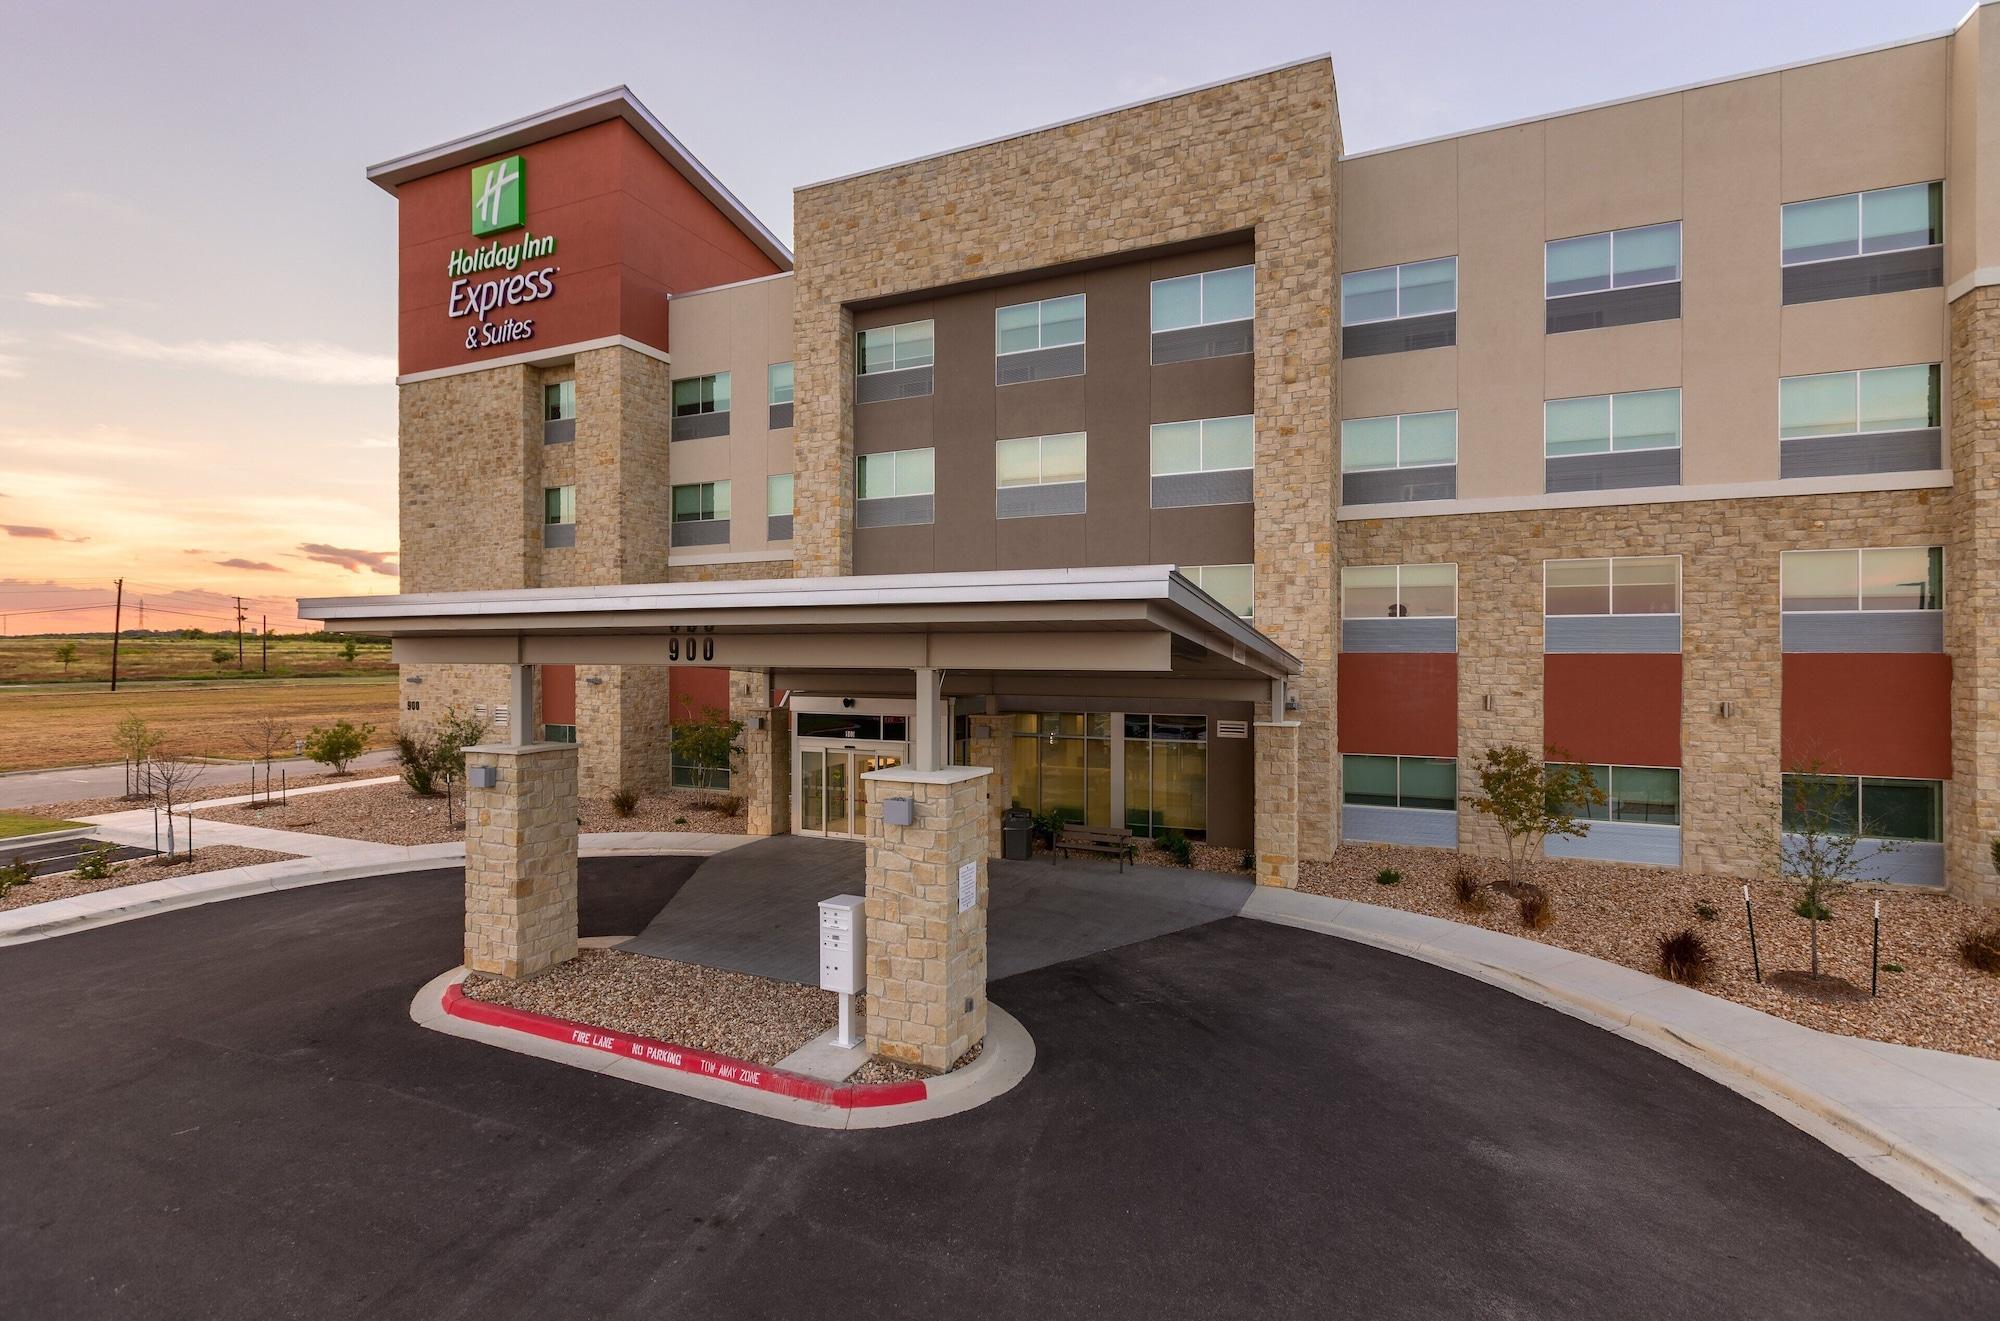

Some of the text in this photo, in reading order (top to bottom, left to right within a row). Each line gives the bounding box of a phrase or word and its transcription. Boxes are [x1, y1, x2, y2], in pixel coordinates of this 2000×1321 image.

[476, 162, 519, 225] H
[447, 232, 554, 277] Holiday Inn
[448, 267, 554, 321] Express
[465, 319, 533, 349] & Suites
[669, 637, 713, 661] 900
[572, 1030, 590, 1044] FIRE
[593, 1035, 614, 1049] LANE
[632, 1043, 643, 1056] NO
[646, 1046, 681, 1066] PARKING
[739, 1069, 761, 1085] ZONE
